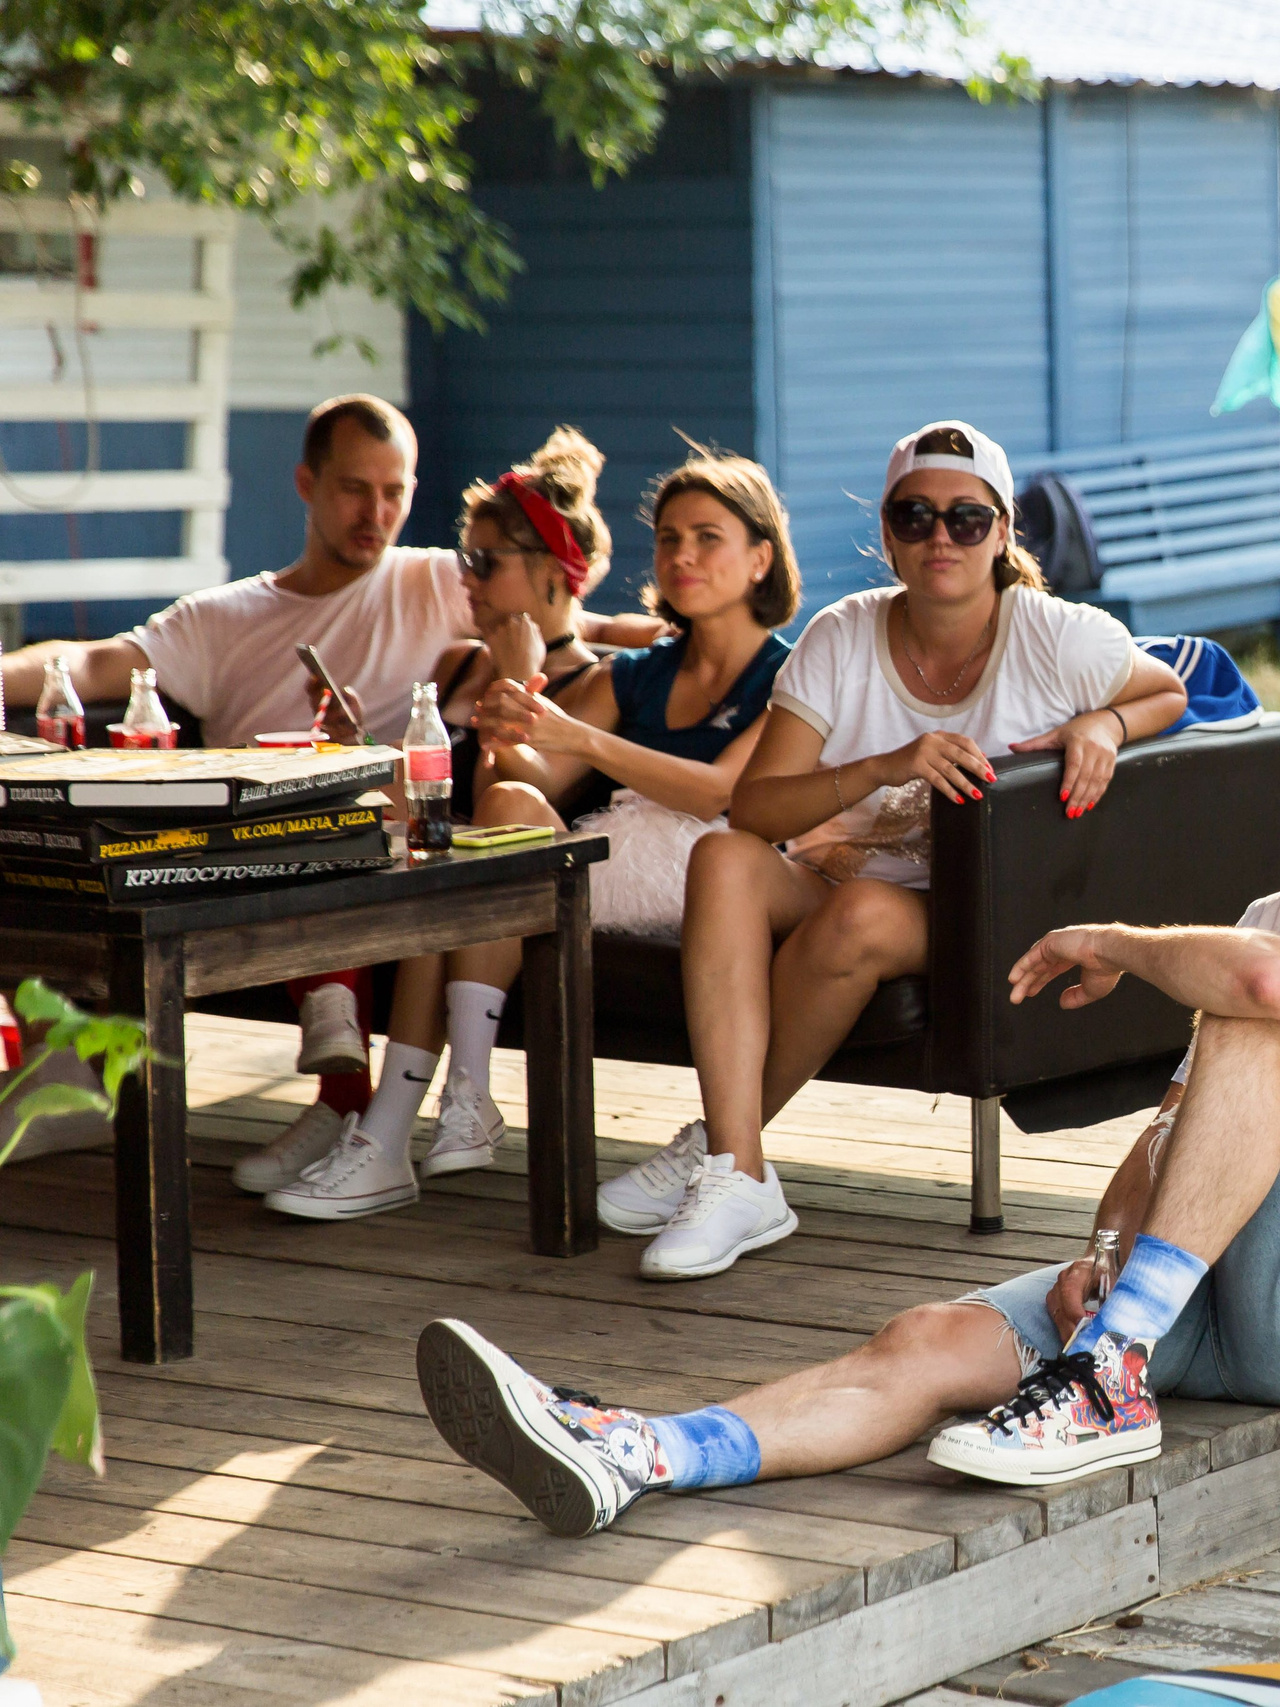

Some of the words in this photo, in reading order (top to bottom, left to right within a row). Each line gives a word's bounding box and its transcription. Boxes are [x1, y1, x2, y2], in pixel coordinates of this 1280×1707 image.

[9, 787, 66, 803] ПИЦЦА
[231, 810, 377, 841] VK.COM/MAFIA_PIZZA
[124, 862, 300, 887] КРУГЛОСУТОЧНАЯ
[947, 1434, 961, 1445] beat
[963, 1440, 974, 1449] the
[976, 1444, 996, 1455] world
